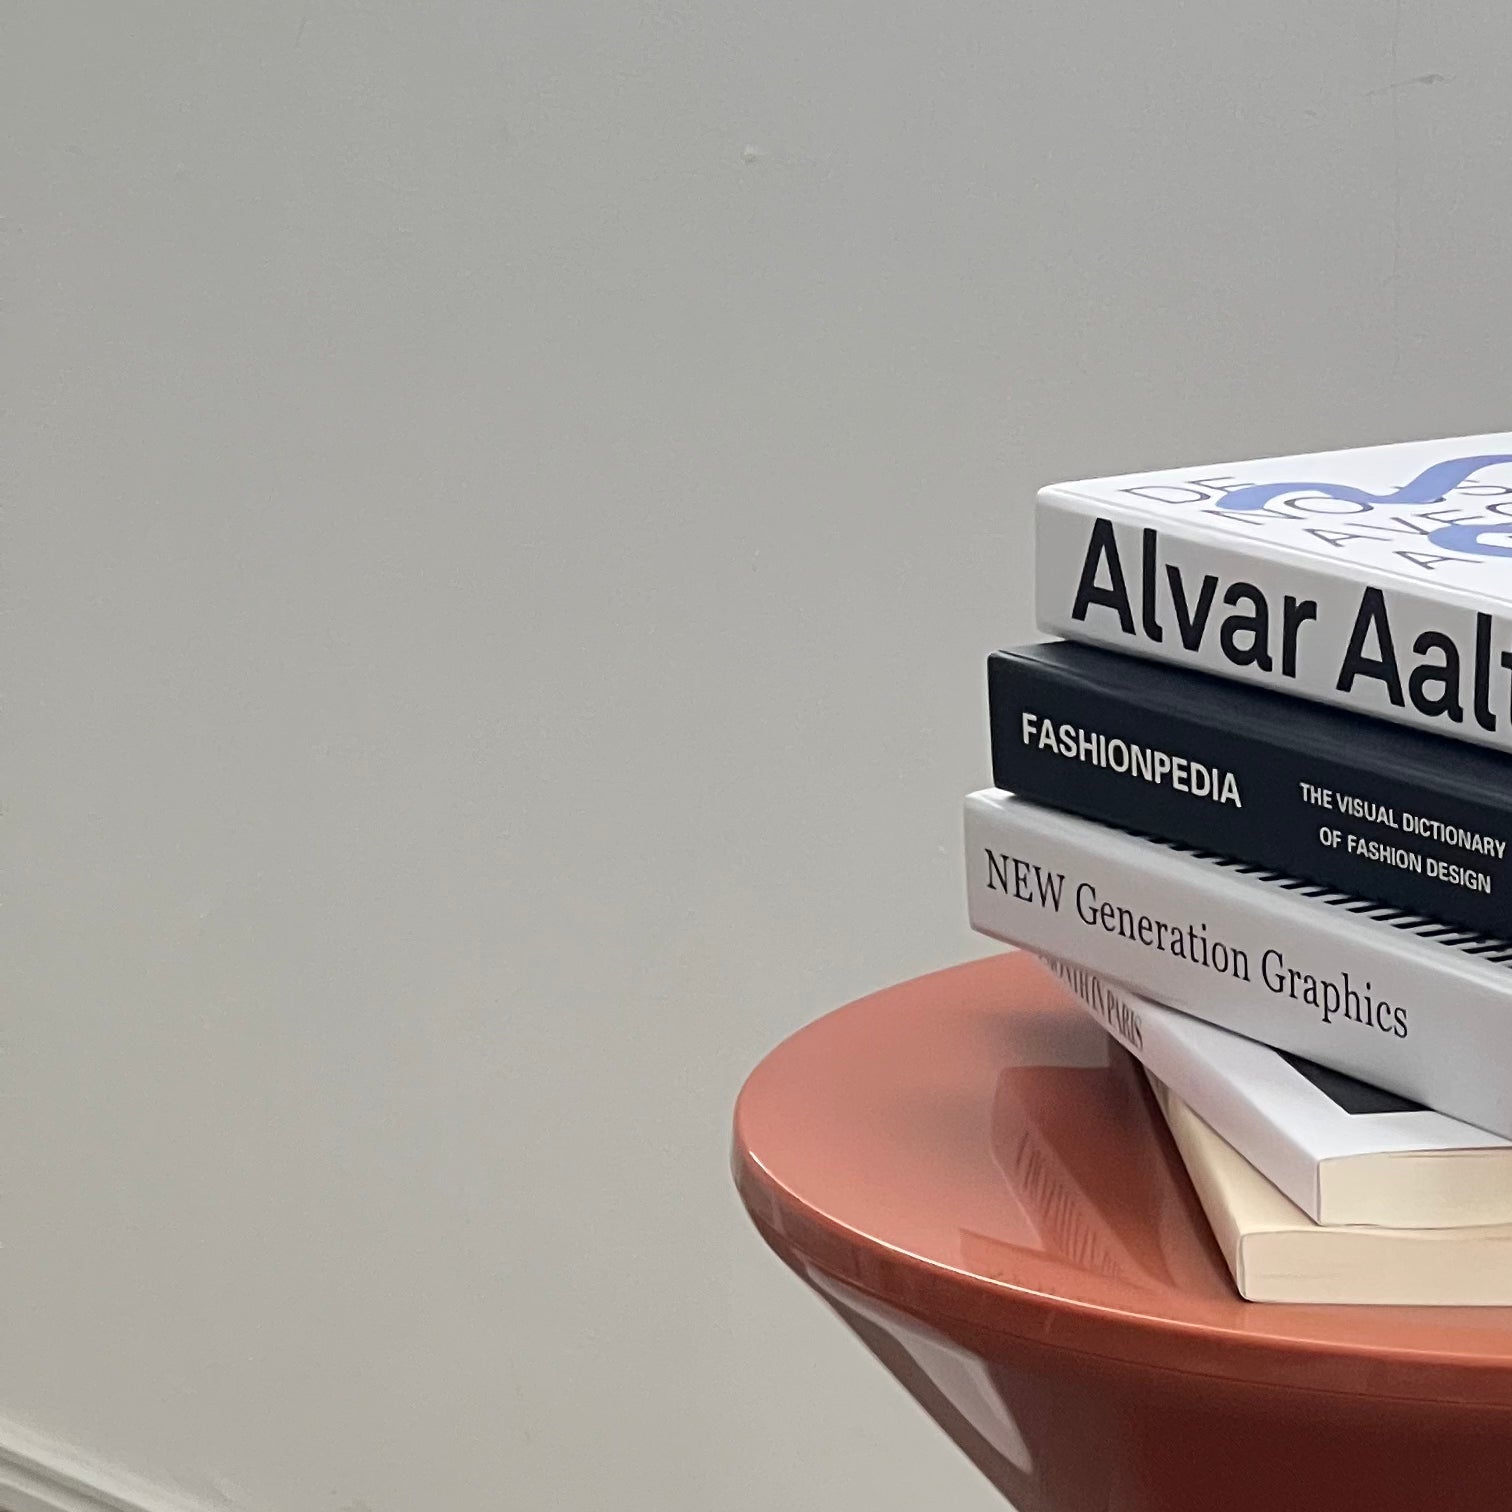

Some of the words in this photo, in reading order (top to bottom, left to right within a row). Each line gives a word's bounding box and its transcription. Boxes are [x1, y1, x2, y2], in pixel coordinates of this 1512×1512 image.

[1071, 517, 1317, 678] Alvar
[1022, 712, 1242, 808] FASHIONPEDIA
[1300, 782, 1332, 809] THE
[1336, 791, 1399, 830] VISUAL
[1403, 812, 1506, 860] DICTIONARY
[1319, 827, 1342, 848] OF
[1347, 835, 1422, 874] FASHION
[1427, 857, 1492, 894] DESIGN
[984, 848, 1067, 912] NEW
[1077, 883, 1250, 982] Generation
[1261, 949, 1409, 1039] Graphics
[1106, 989, 1144, 1052] PARIS
